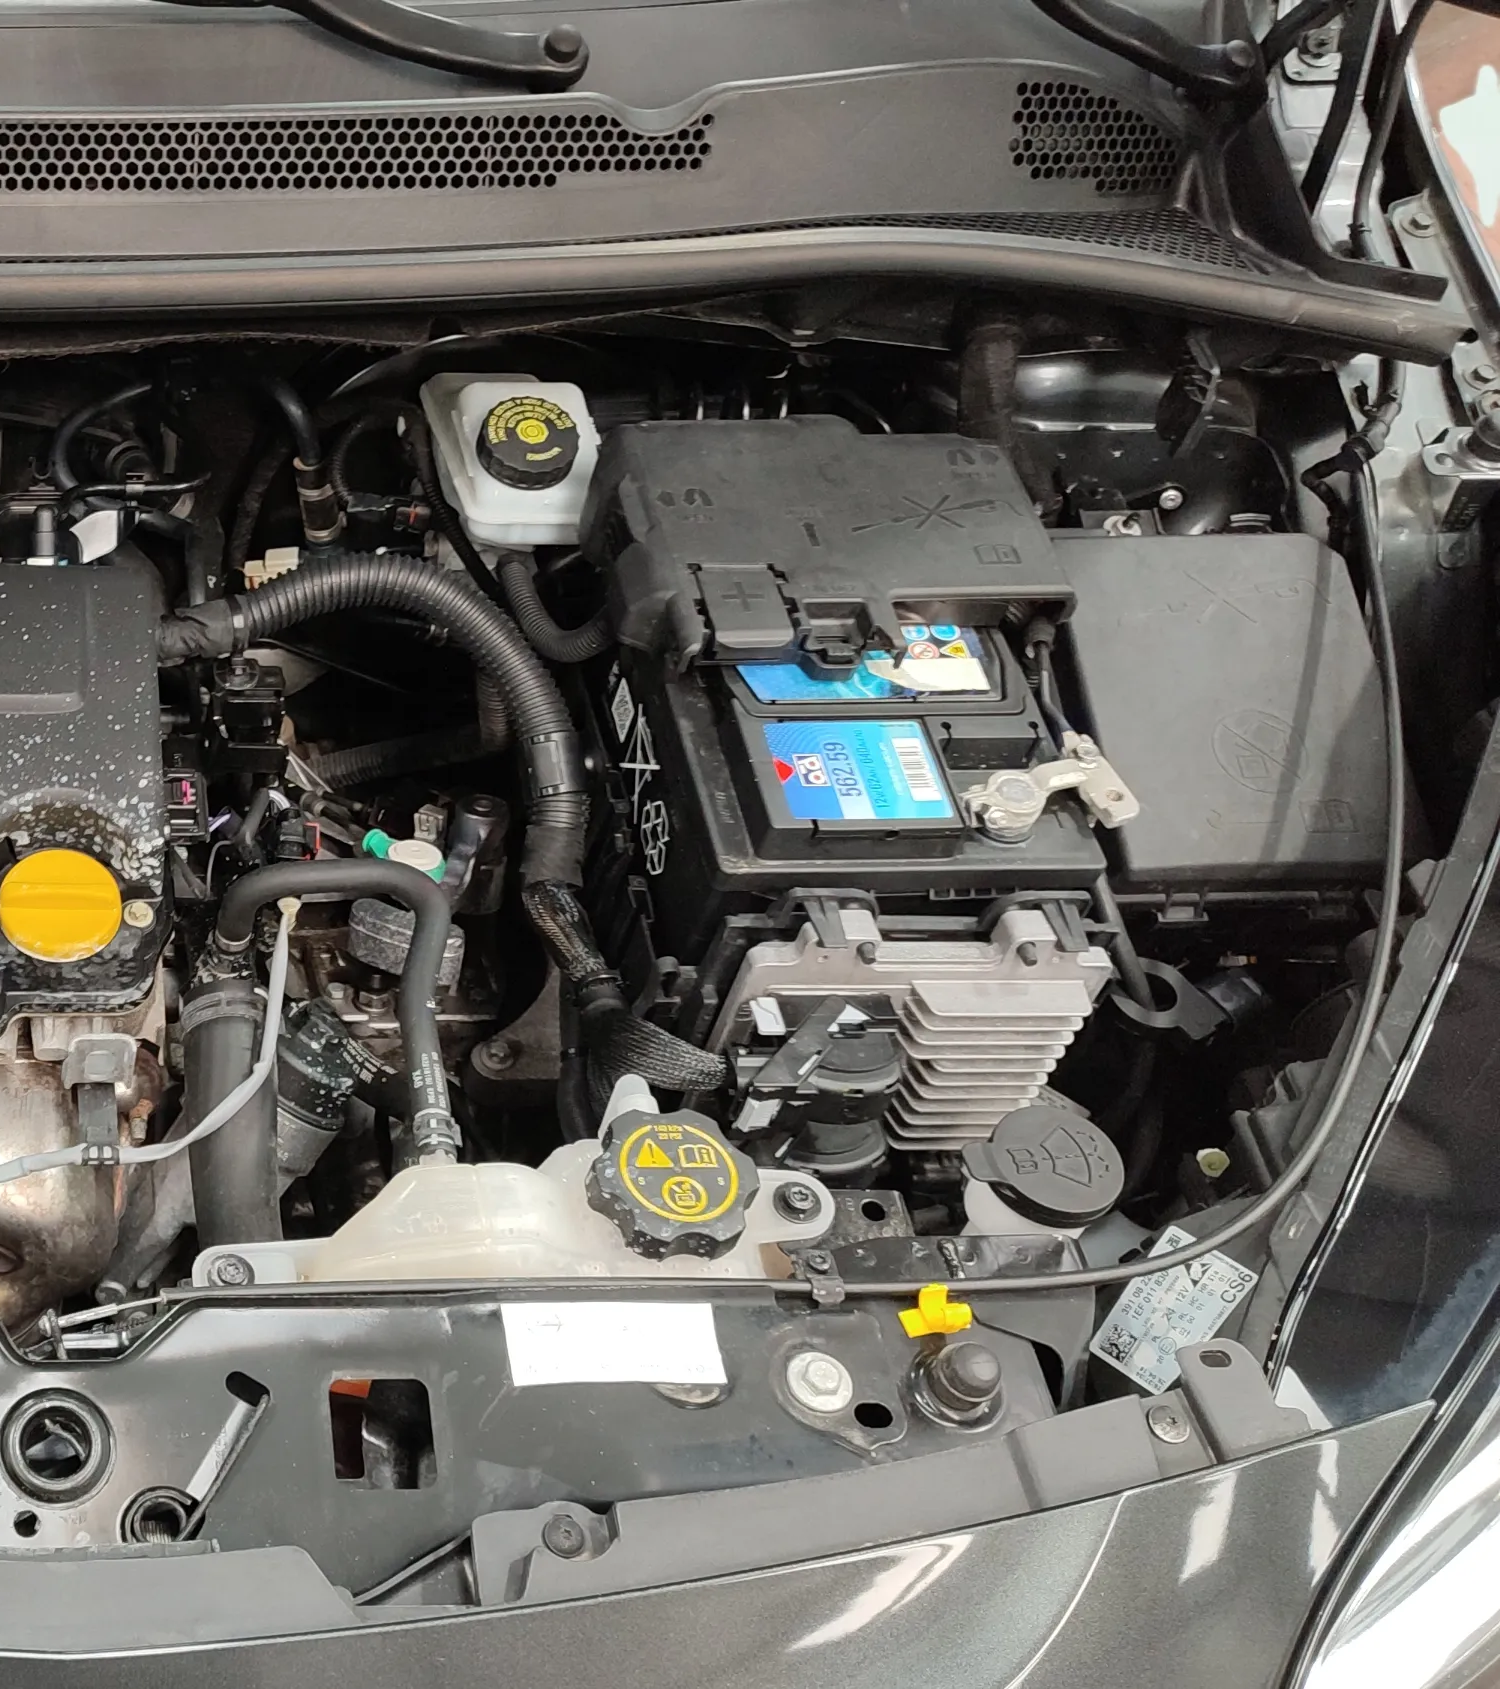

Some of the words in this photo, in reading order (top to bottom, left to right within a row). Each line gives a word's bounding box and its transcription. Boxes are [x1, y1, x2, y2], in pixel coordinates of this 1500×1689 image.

[823, 742, 862, 797] 562.59
[1120, 1299, 1135, 1315] 391
[1131, 1286, 1143, 1298] 08
[1174, 1285, 1190, 1302] 12V
[1188, 1295, 1198, 1307] HC
[1220, 1271, 1253, 1304] CS6
[1131, 1303, 1145, 1320] 1EF
[1142, 1287, 1157, 1303] 011
